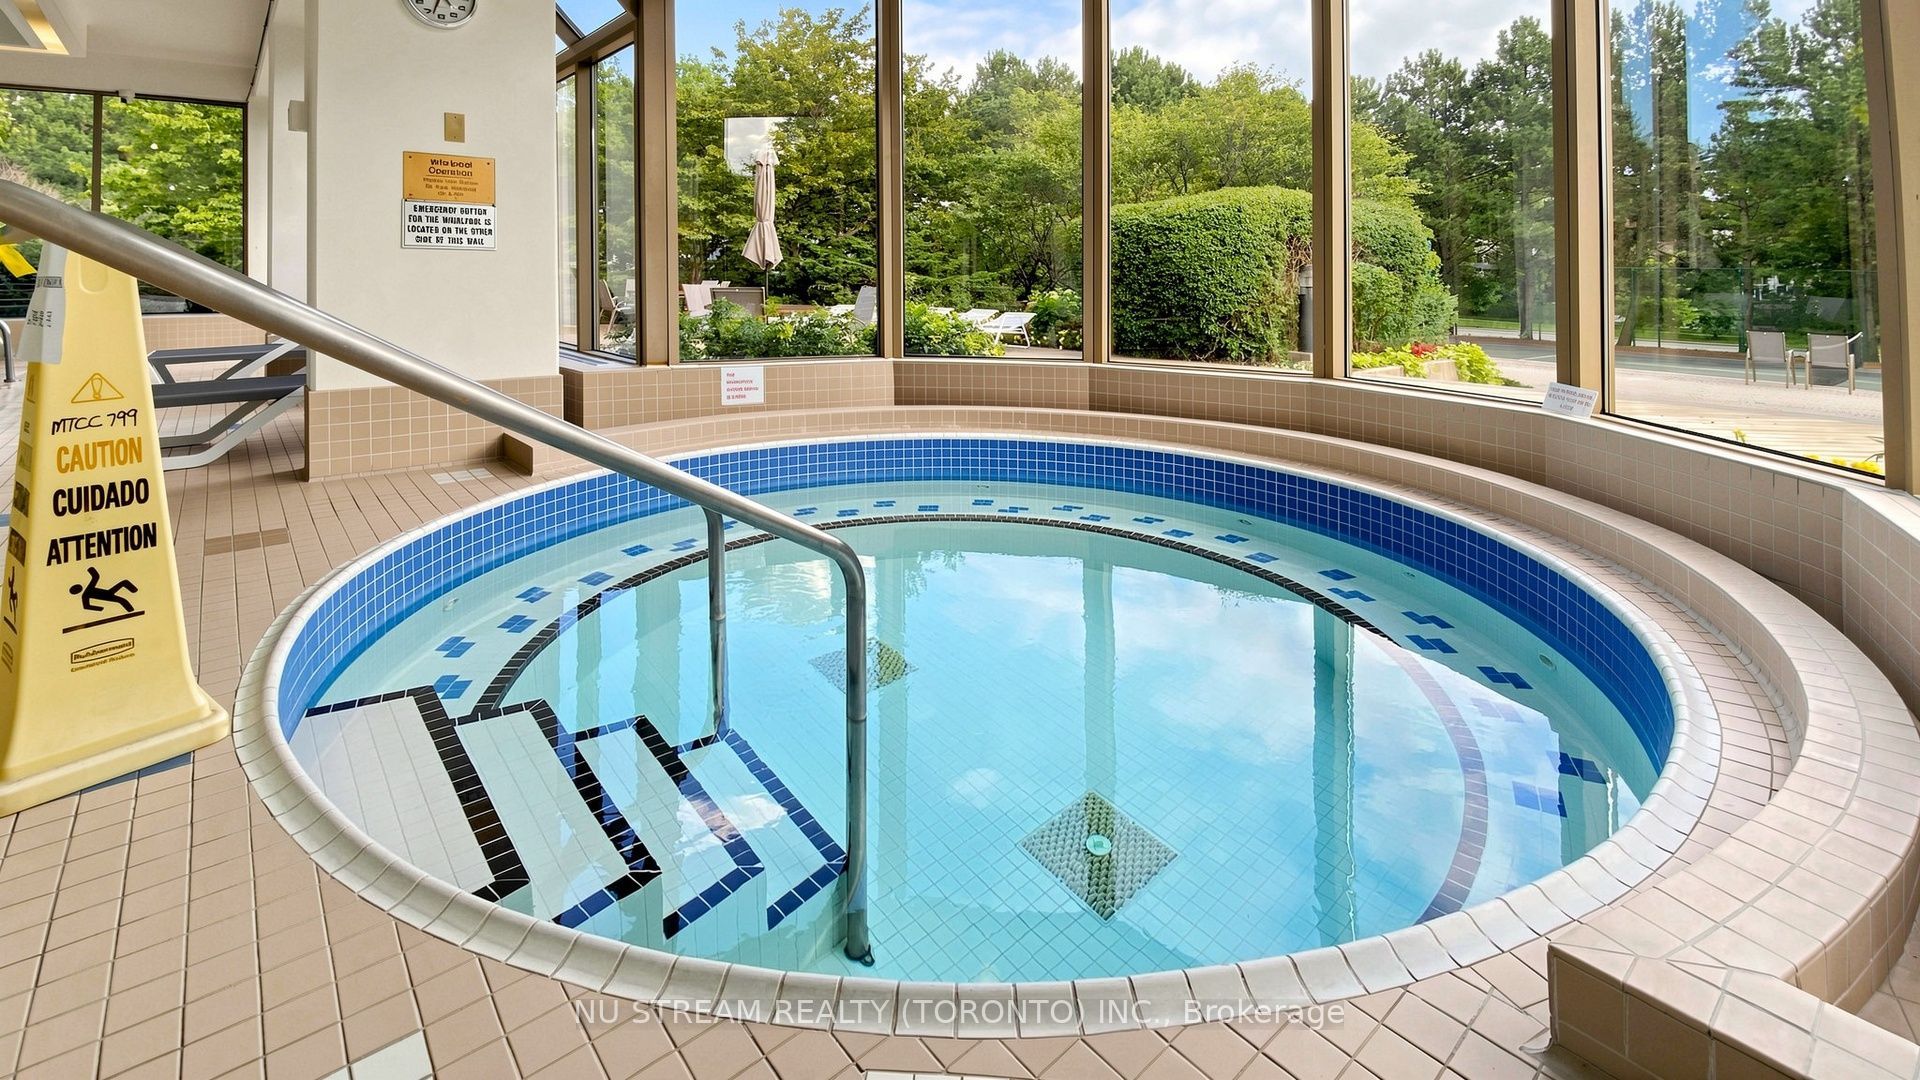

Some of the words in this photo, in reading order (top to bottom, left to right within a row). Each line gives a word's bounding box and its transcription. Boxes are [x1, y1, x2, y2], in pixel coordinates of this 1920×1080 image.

[407, 225, 440, 233] LOCATED
[51, 415, 102, 435] MTCC
[107, 408, 138, 427] 799
[56, 436, 143, 474] CAUTION
[52, 478, 149, 517] CUIDADO
[46, 522, 157, 566] ATTENTION
